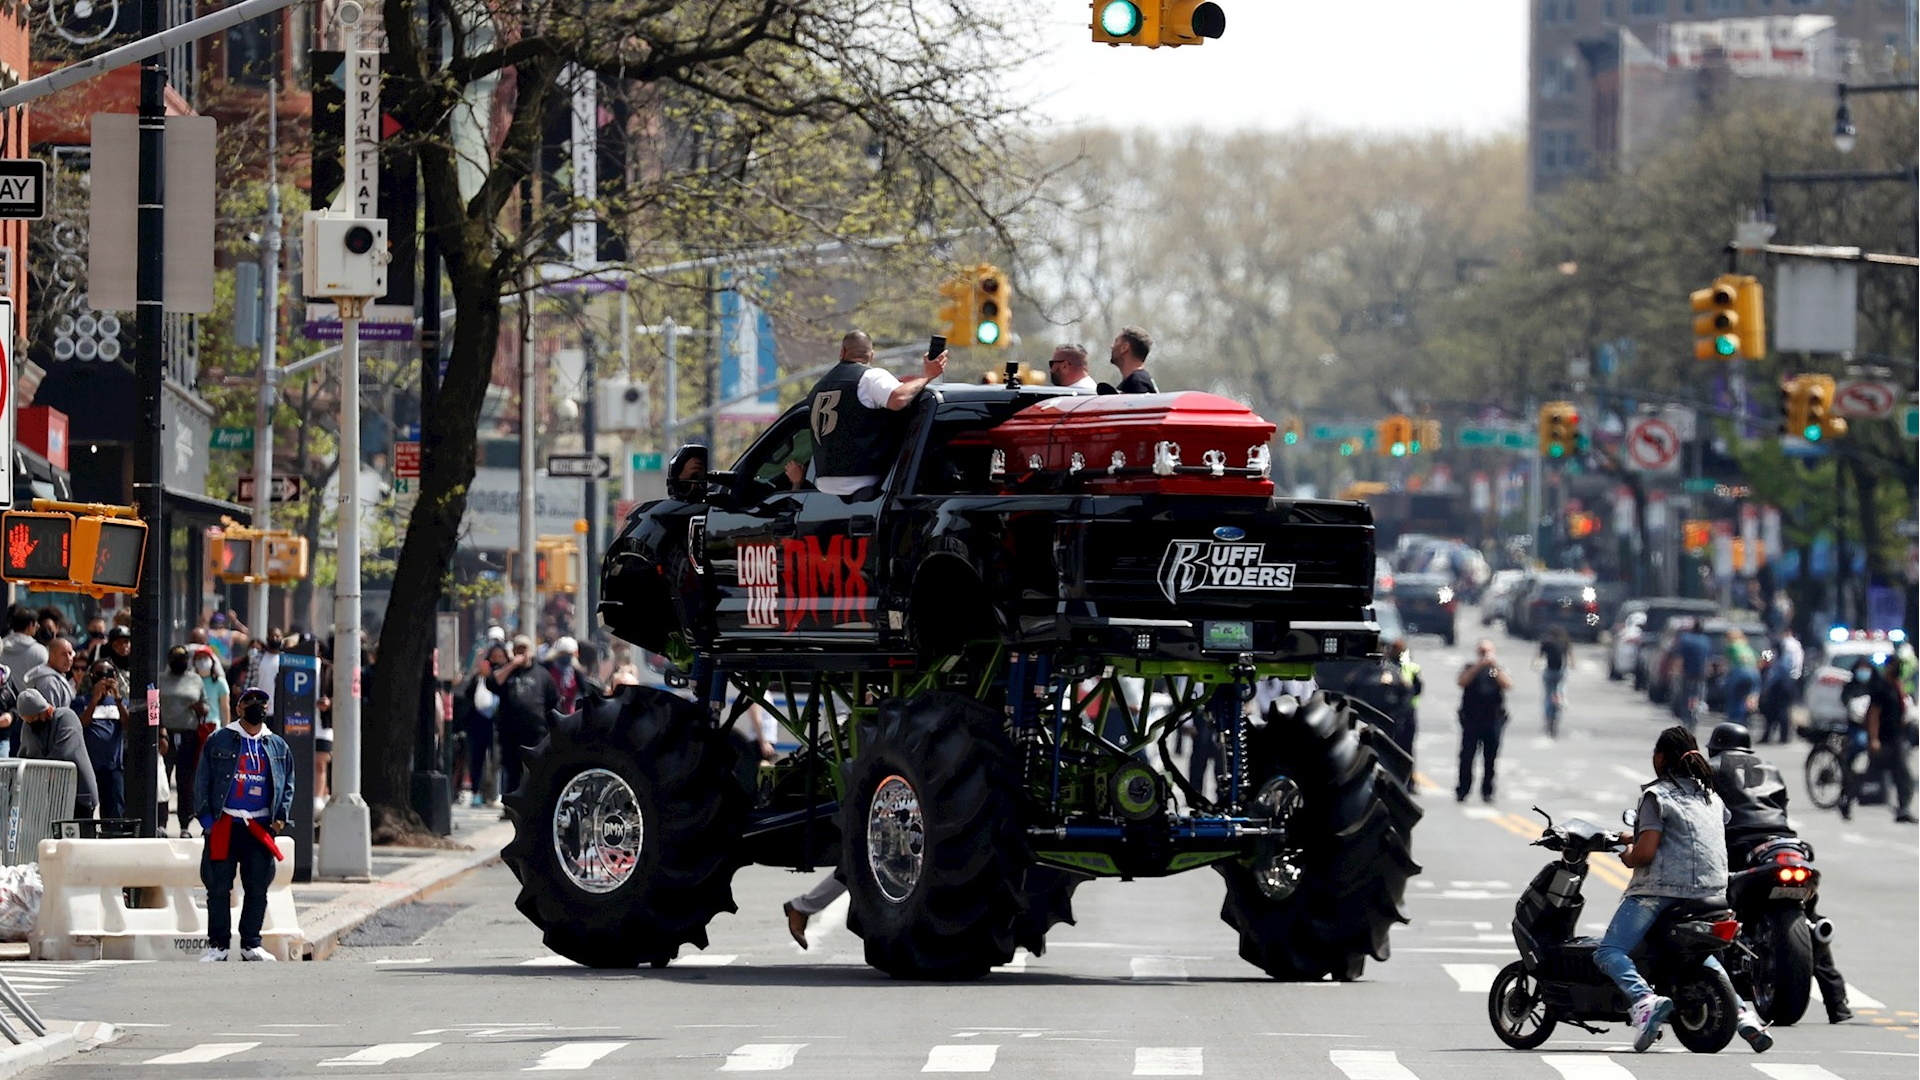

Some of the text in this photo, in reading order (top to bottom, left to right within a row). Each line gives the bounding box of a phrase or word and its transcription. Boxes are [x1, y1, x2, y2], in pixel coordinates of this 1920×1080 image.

[359, 56, 372, 138] NORTH
[737, 545, 778, 585] LONG
[781, 534, 869, 636] DMX
[746, 586, 779, 625] LIVE
[294, 672, 308, 692] P
[9, 808, 18, 851] NYPD
[604, 822, 624, 838] DMX
[173, 938, 210, 949] YODOCK
